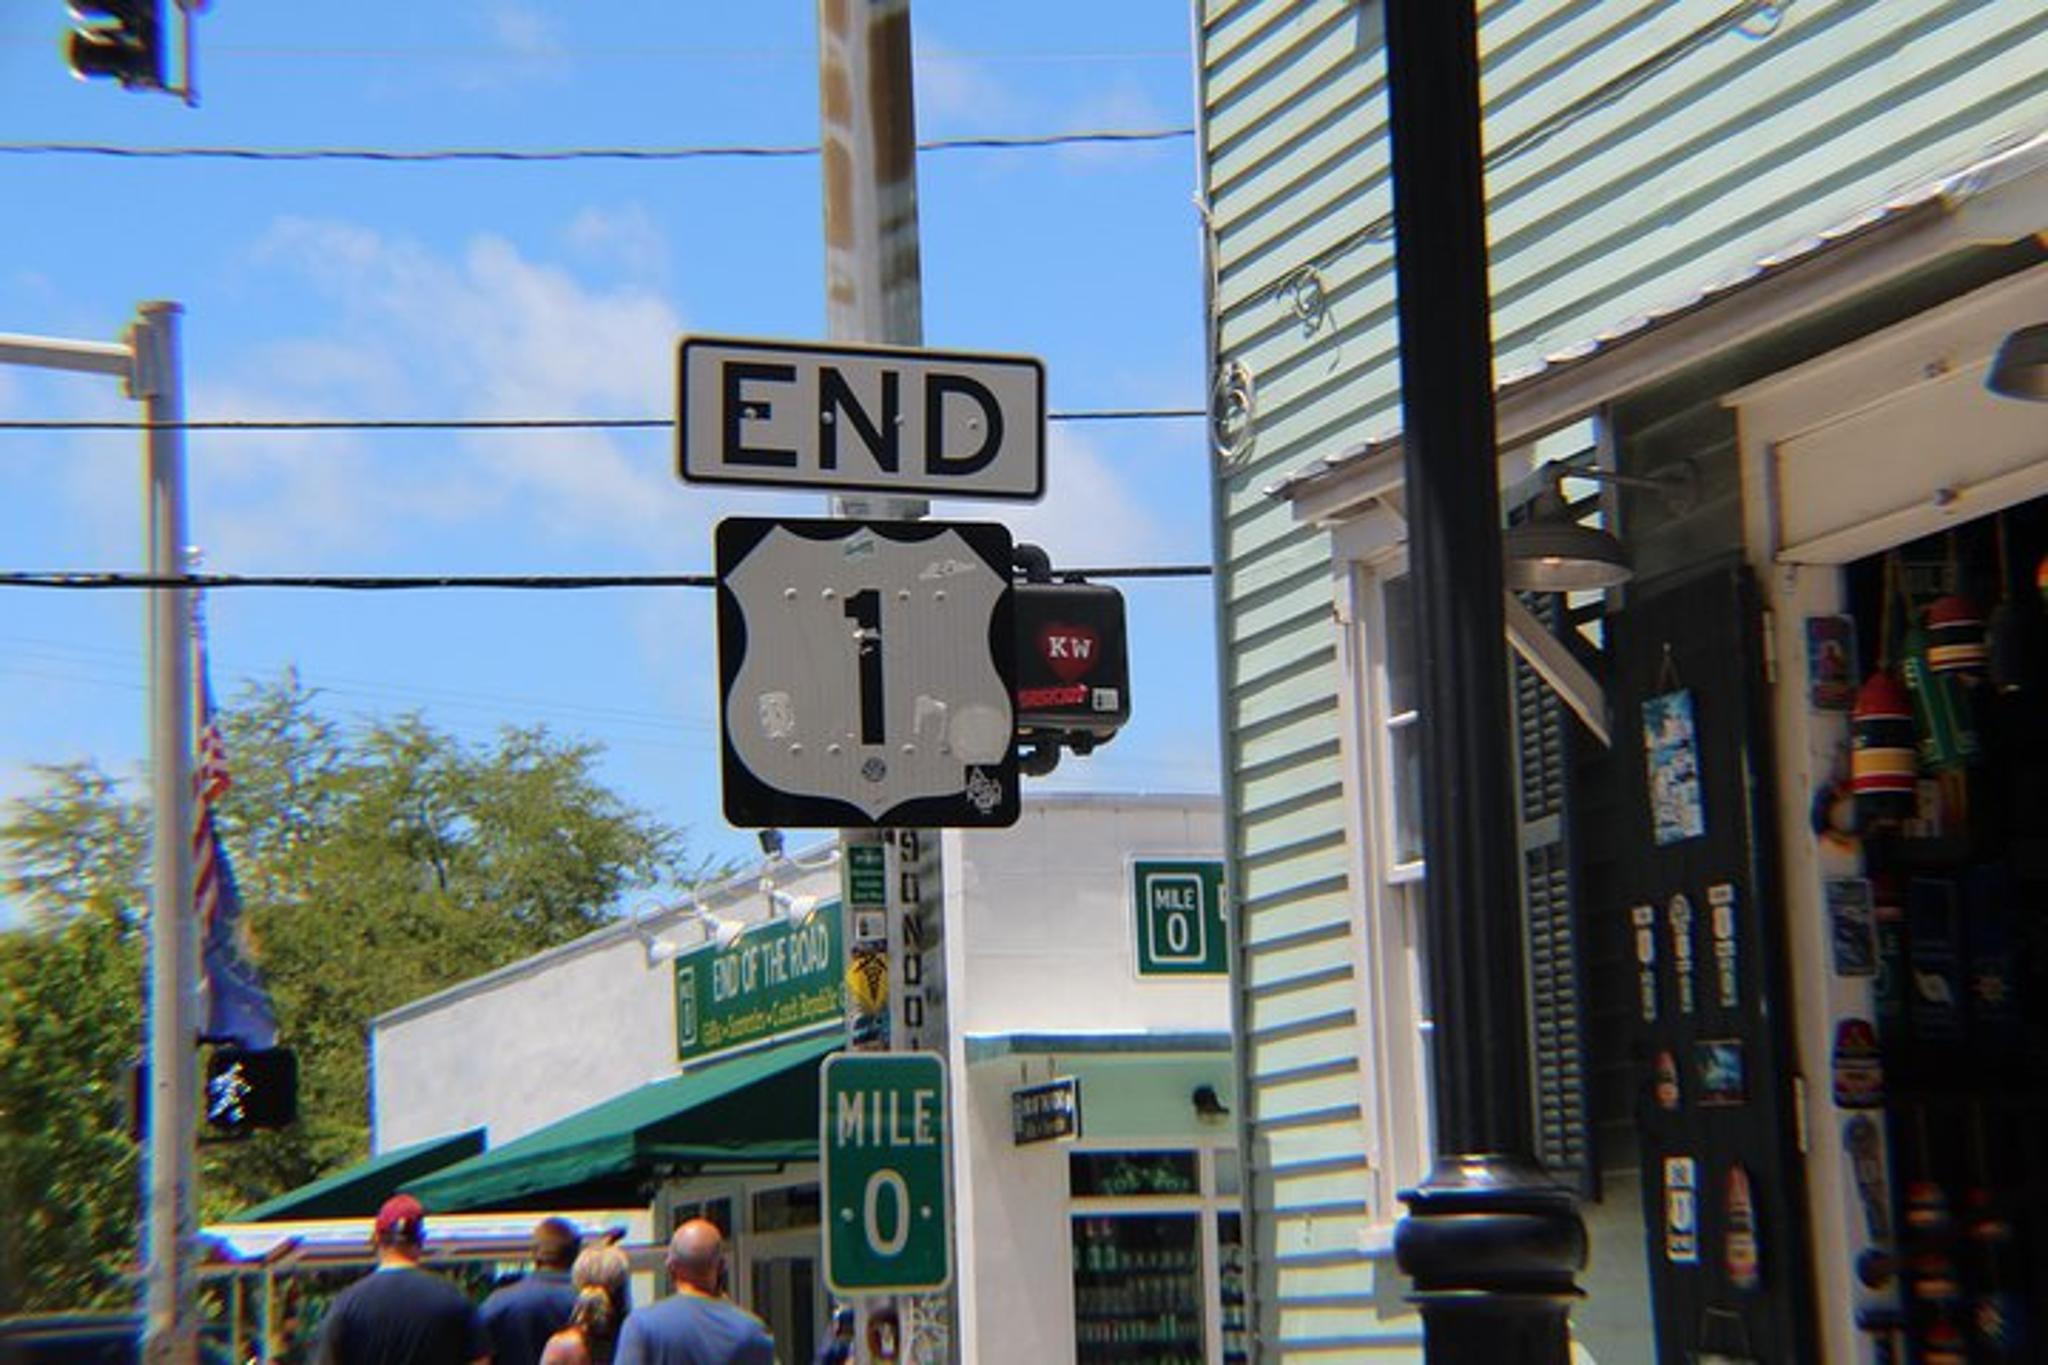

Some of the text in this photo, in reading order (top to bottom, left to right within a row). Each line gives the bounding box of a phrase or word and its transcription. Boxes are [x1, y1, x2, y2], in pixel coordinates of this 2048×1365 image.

[722, 361, 1005, 476] END
[844, 589, 885, 745] 1
[1048, 636, 1093, 658] KW
[1154, 887, 1195, 910] MILE
[1167, 912, 1189, 952] 0
[713, 922, 830, 1002] END OF THE ROAD
[837, 1089, 935, 1147] MILE
[863, 1168, 910, 1255] 0
